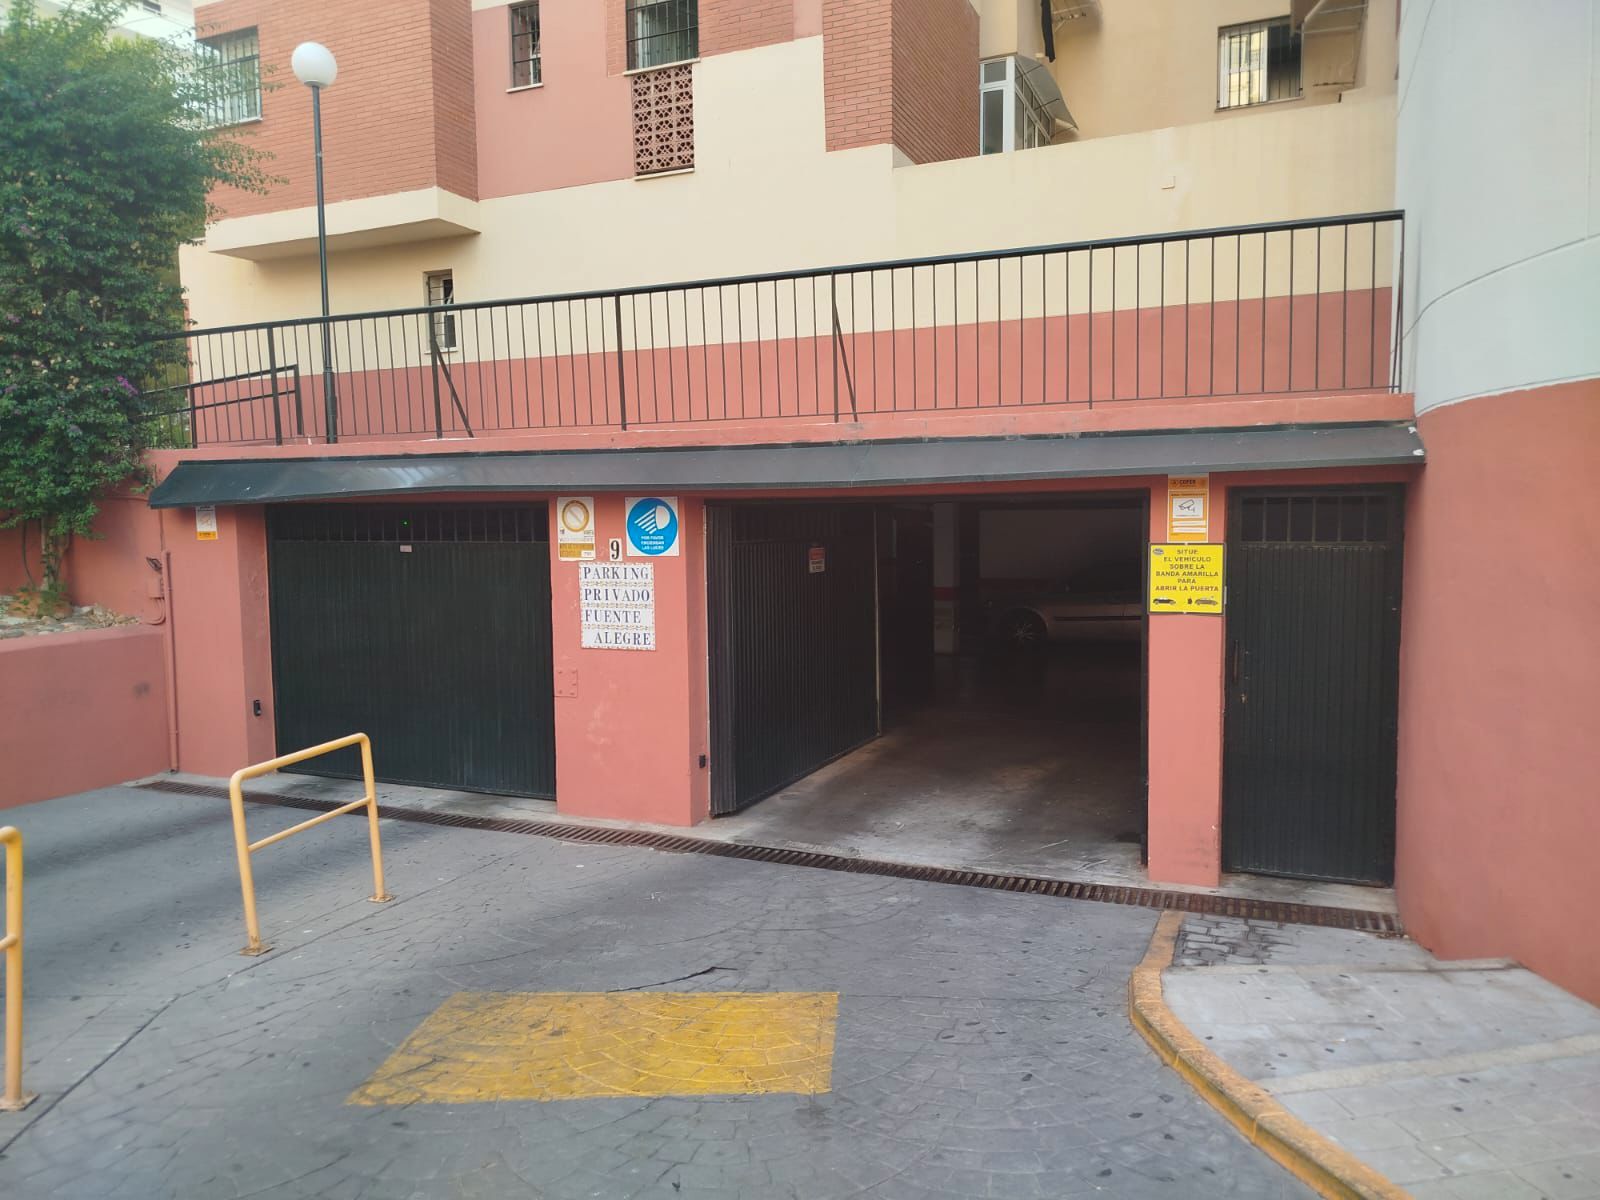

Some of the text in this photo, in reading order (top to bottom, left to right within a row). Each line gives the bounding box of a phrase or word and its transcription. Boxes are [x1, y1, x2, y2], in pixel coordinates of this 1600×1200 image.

[610, 540, 620, 560] 9
[583, 566, 648, 580] PARKING
[584, 588, 650, 602] PRIVADO
[585, 610, 640, 623] FUENTE
[594, 632, 651, 645] ALEGRE
